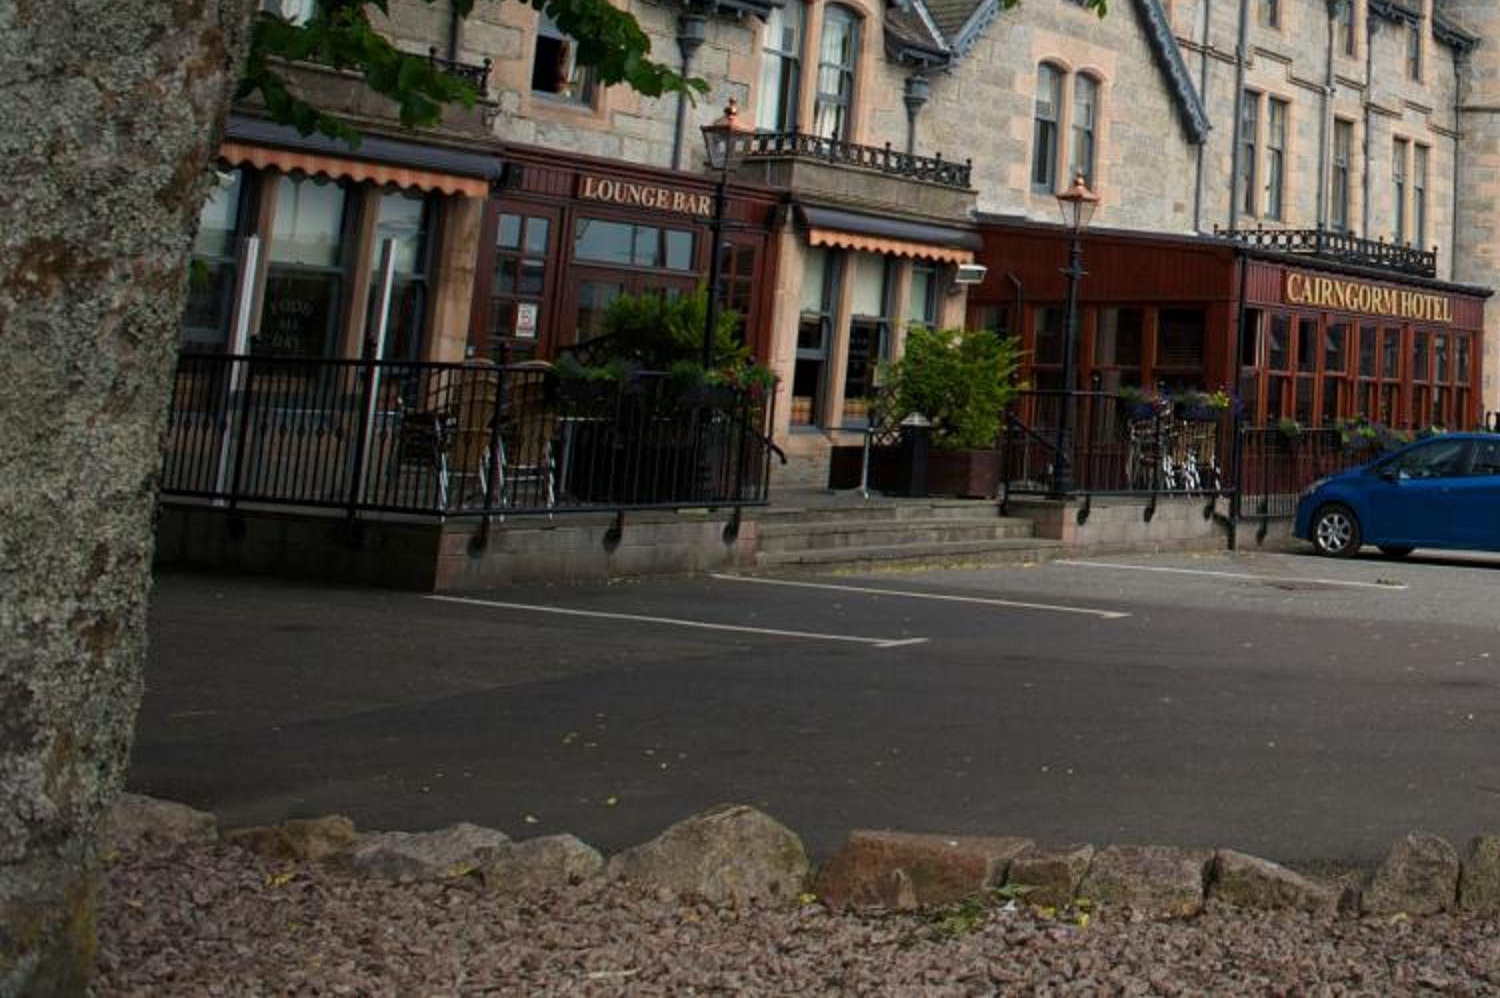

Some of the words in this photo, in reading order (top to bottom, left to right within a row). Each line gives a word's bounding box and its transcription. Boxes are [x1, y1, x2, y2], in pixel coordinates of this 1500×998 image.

[584, 177, 670, 209] LOUNGE
[672, 190, 712, 216] BAR
[1287, 272, 1397, 316] CAIRNGORM
[1401, 290, 1453, 322] HOTEL
